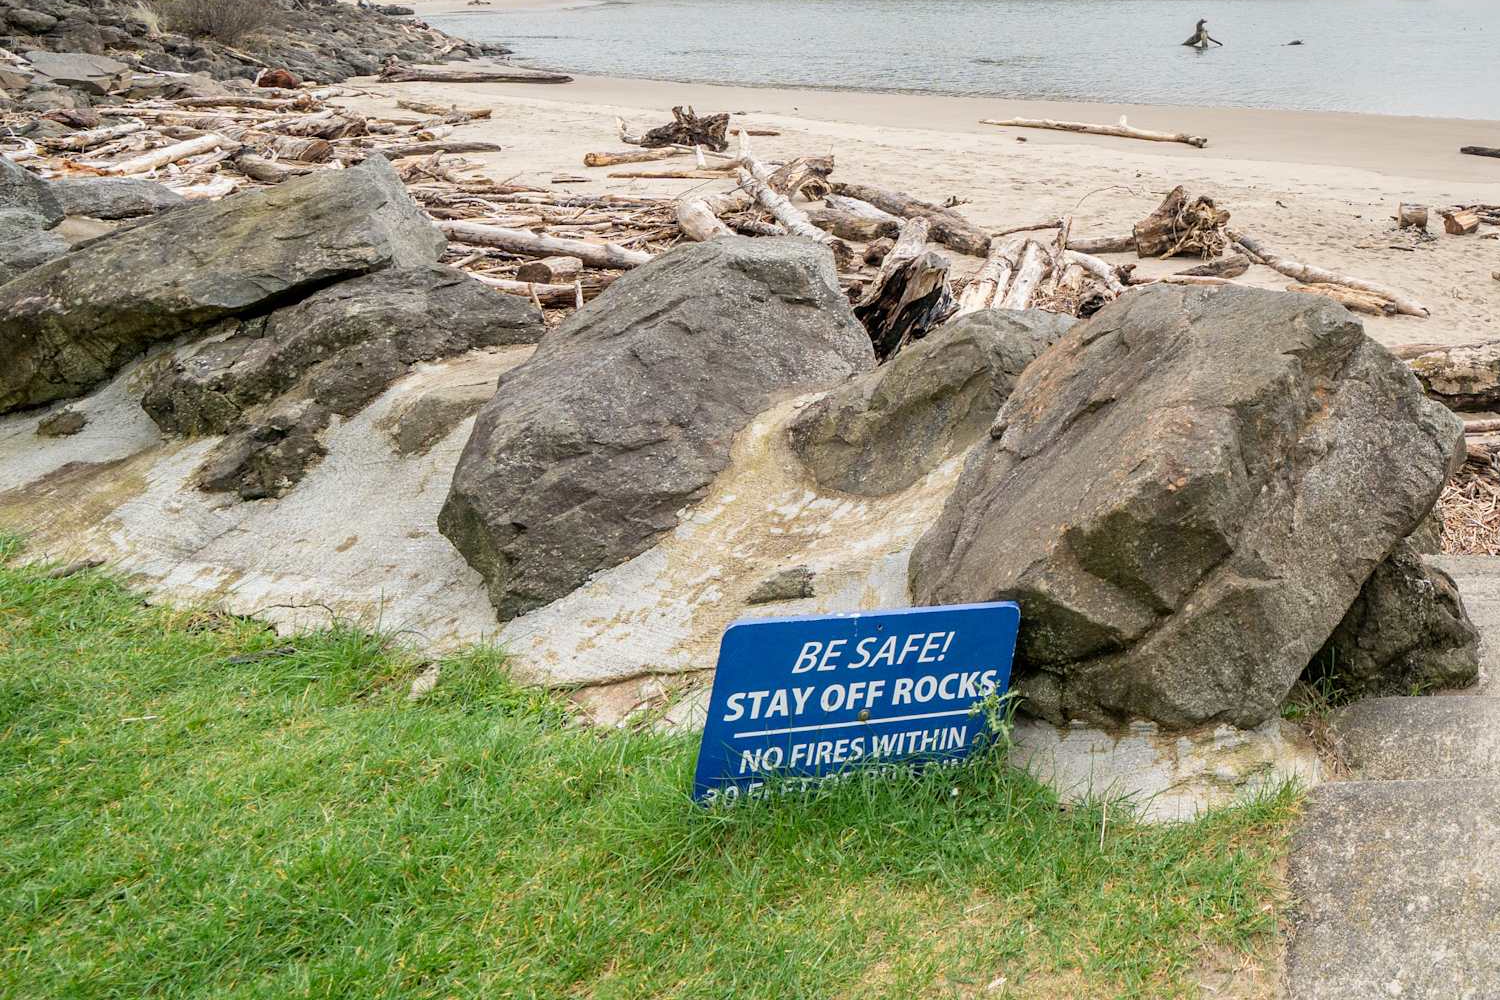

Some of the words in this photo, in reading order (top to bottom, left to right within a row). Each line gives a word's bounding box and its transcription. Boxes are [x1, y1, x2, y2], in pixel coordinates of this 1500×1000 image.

[792, 639, 847, 674] BE
[848, 631, 955, 669] SAFE!
[723, 686, 816, 722] STAY
[820, 680, 886, 712] OFF
[891, 669, 998, 706] ROCKS
[739, 745, 784, 774] NO
[789, 737, 865, 769] FIRES
[871, 725, 968, 758] WITHIN
